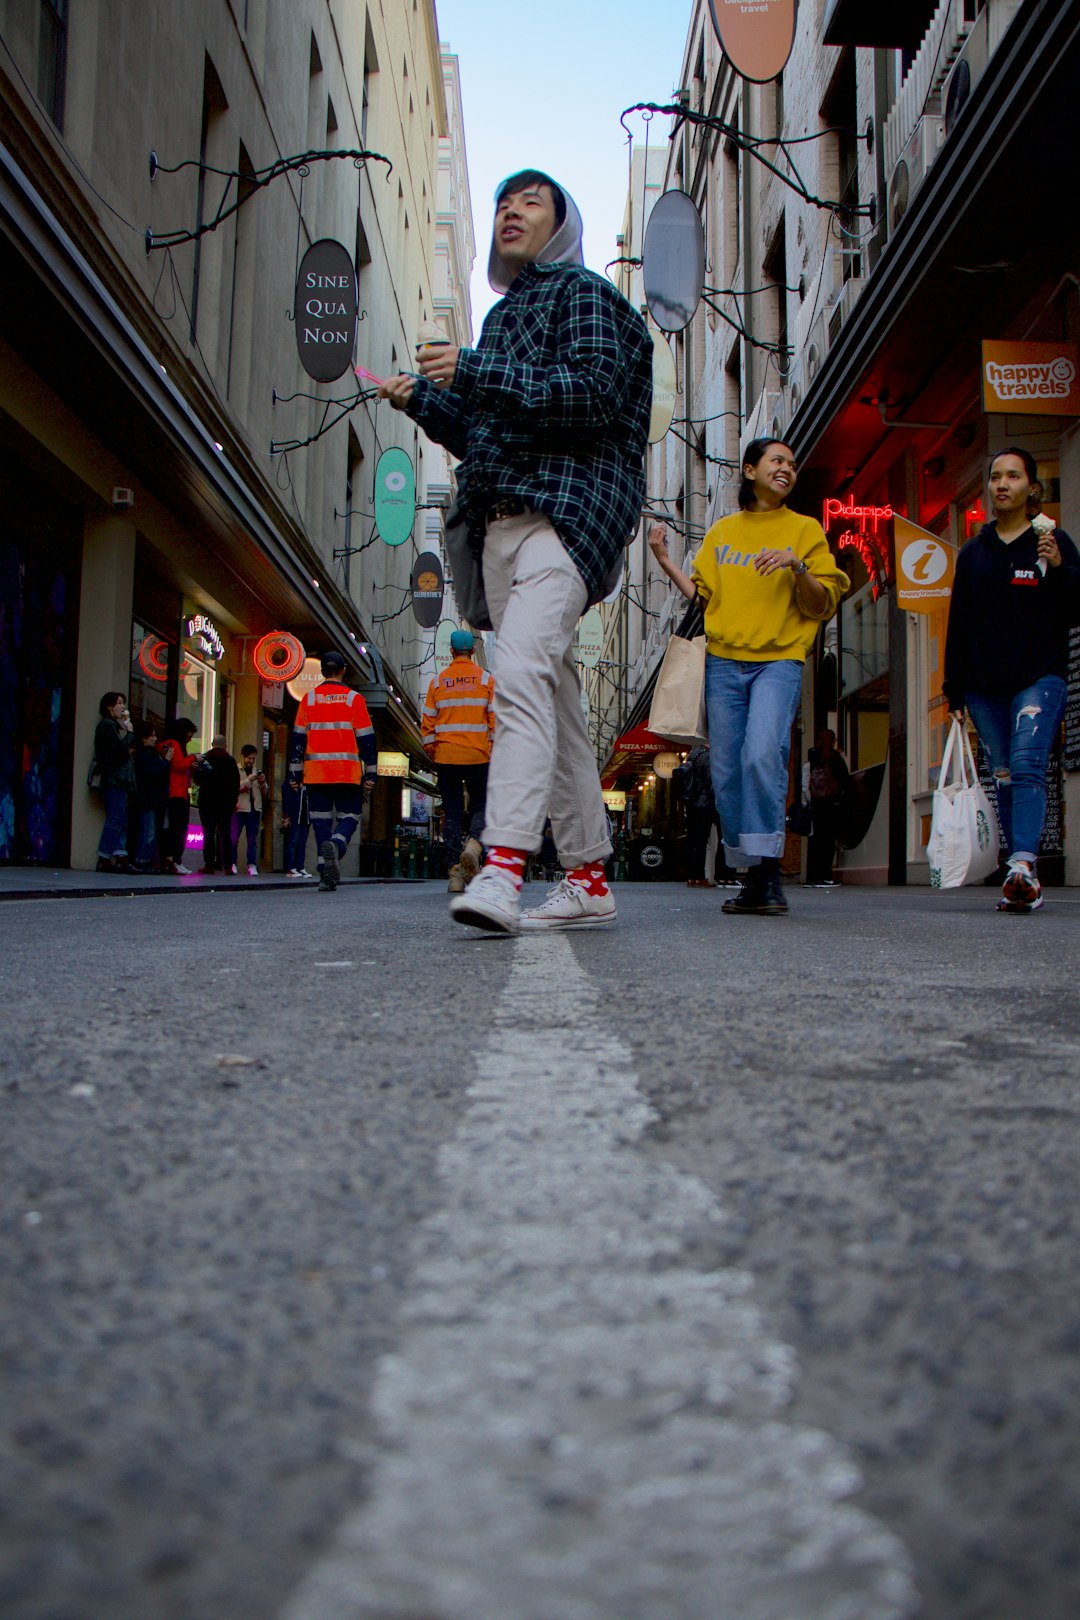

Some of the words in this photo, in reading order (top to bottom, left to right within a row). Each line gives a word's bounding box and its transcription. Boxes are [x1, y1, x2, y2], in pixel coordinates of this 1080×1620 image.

[740, 4, 768, 13] travel
[306, 272, 349, 288] SINE
[306, 299, 348, 319] QUA
[304, 328, 348, 344] NON
[989, 365, 1050, 383] happy
[997, 379, 1067, 396] travels
[456, 676, 477, 685] MCT
[378, 768, 407, 777] PASTA
